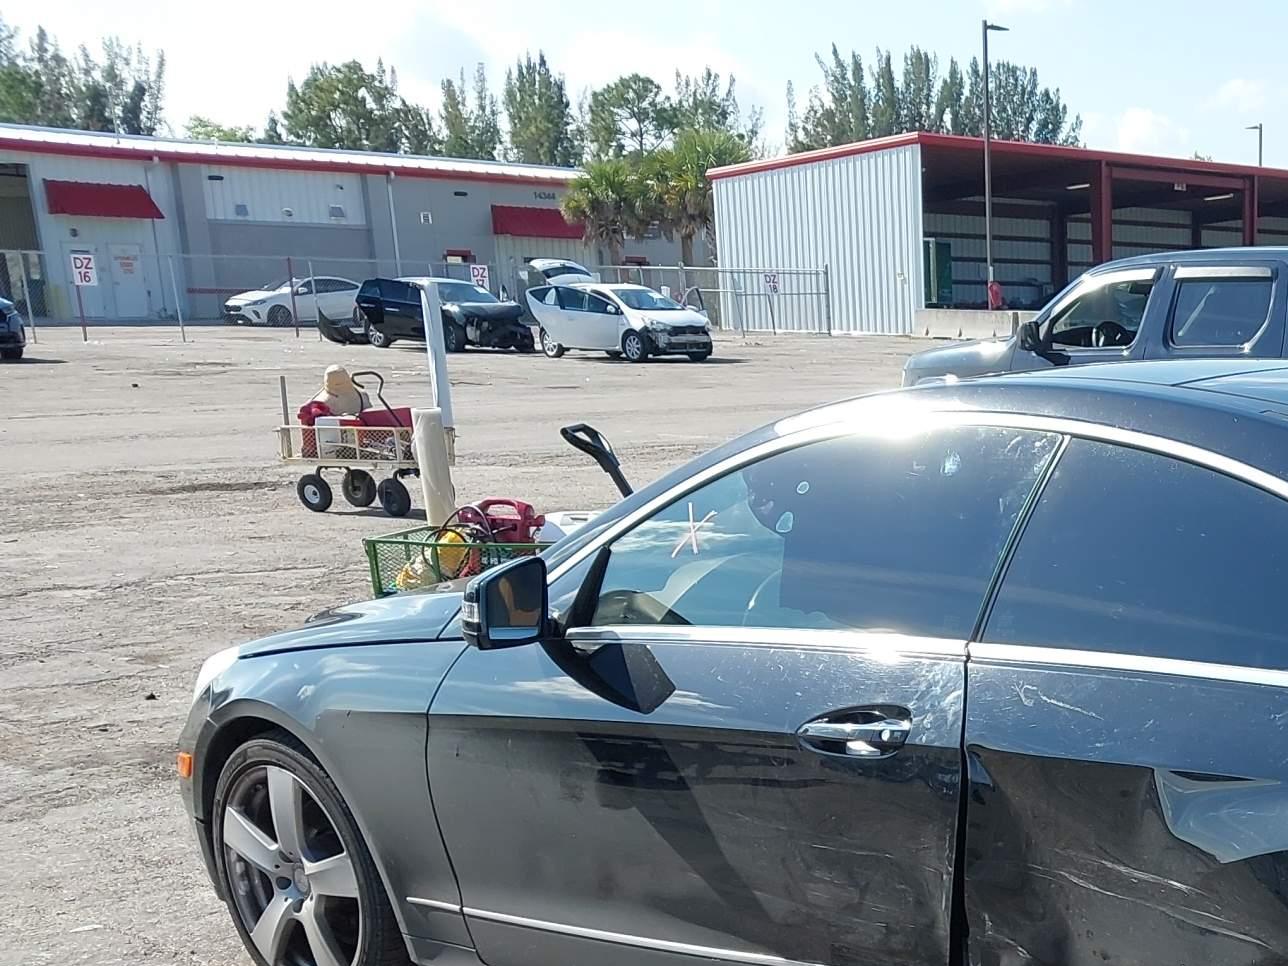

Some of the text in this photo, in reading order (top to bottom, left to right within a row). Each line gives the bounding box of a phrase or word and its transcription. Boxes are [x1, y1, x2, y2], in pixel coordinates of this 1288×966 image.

[73, 257, 93, 270] DZ
[78, 271, 91, 283] 16
[472, 267, 487, 278] DZ
[764, 274, 778, 284] DZ
[769, 284, 778, 293] 18
